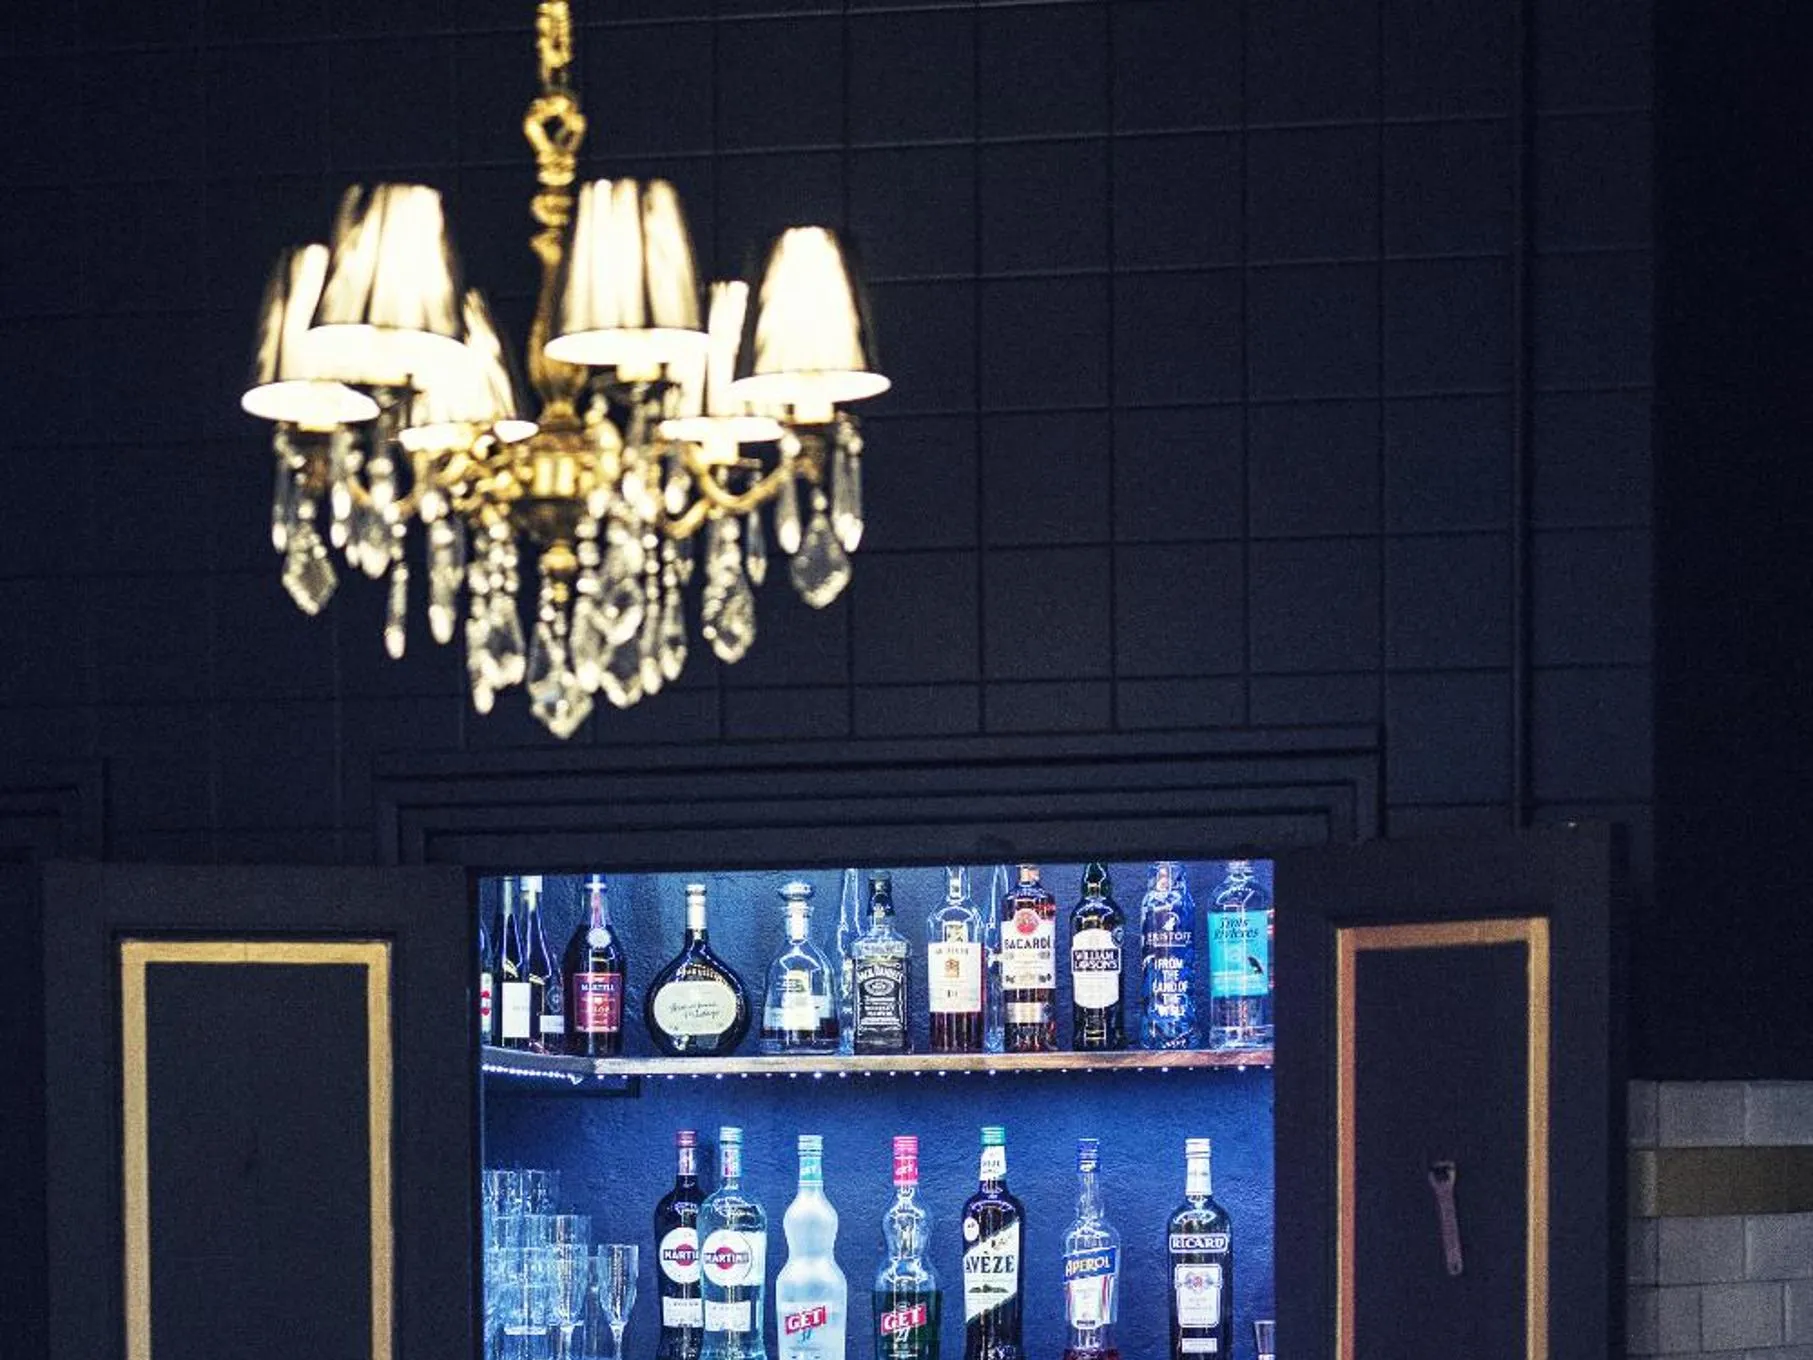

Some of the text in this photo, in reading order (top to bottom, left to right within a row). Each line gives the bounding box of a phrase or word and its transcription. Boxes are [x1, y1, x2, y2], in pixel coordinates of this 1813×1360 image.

[1172, 1238, 1225, 1249] RICARD
[1065, 1255, 1111, 1277] APEROL
[787, 1308, 823, 1330] GET
[884, 1306, 922, 1331] GET
